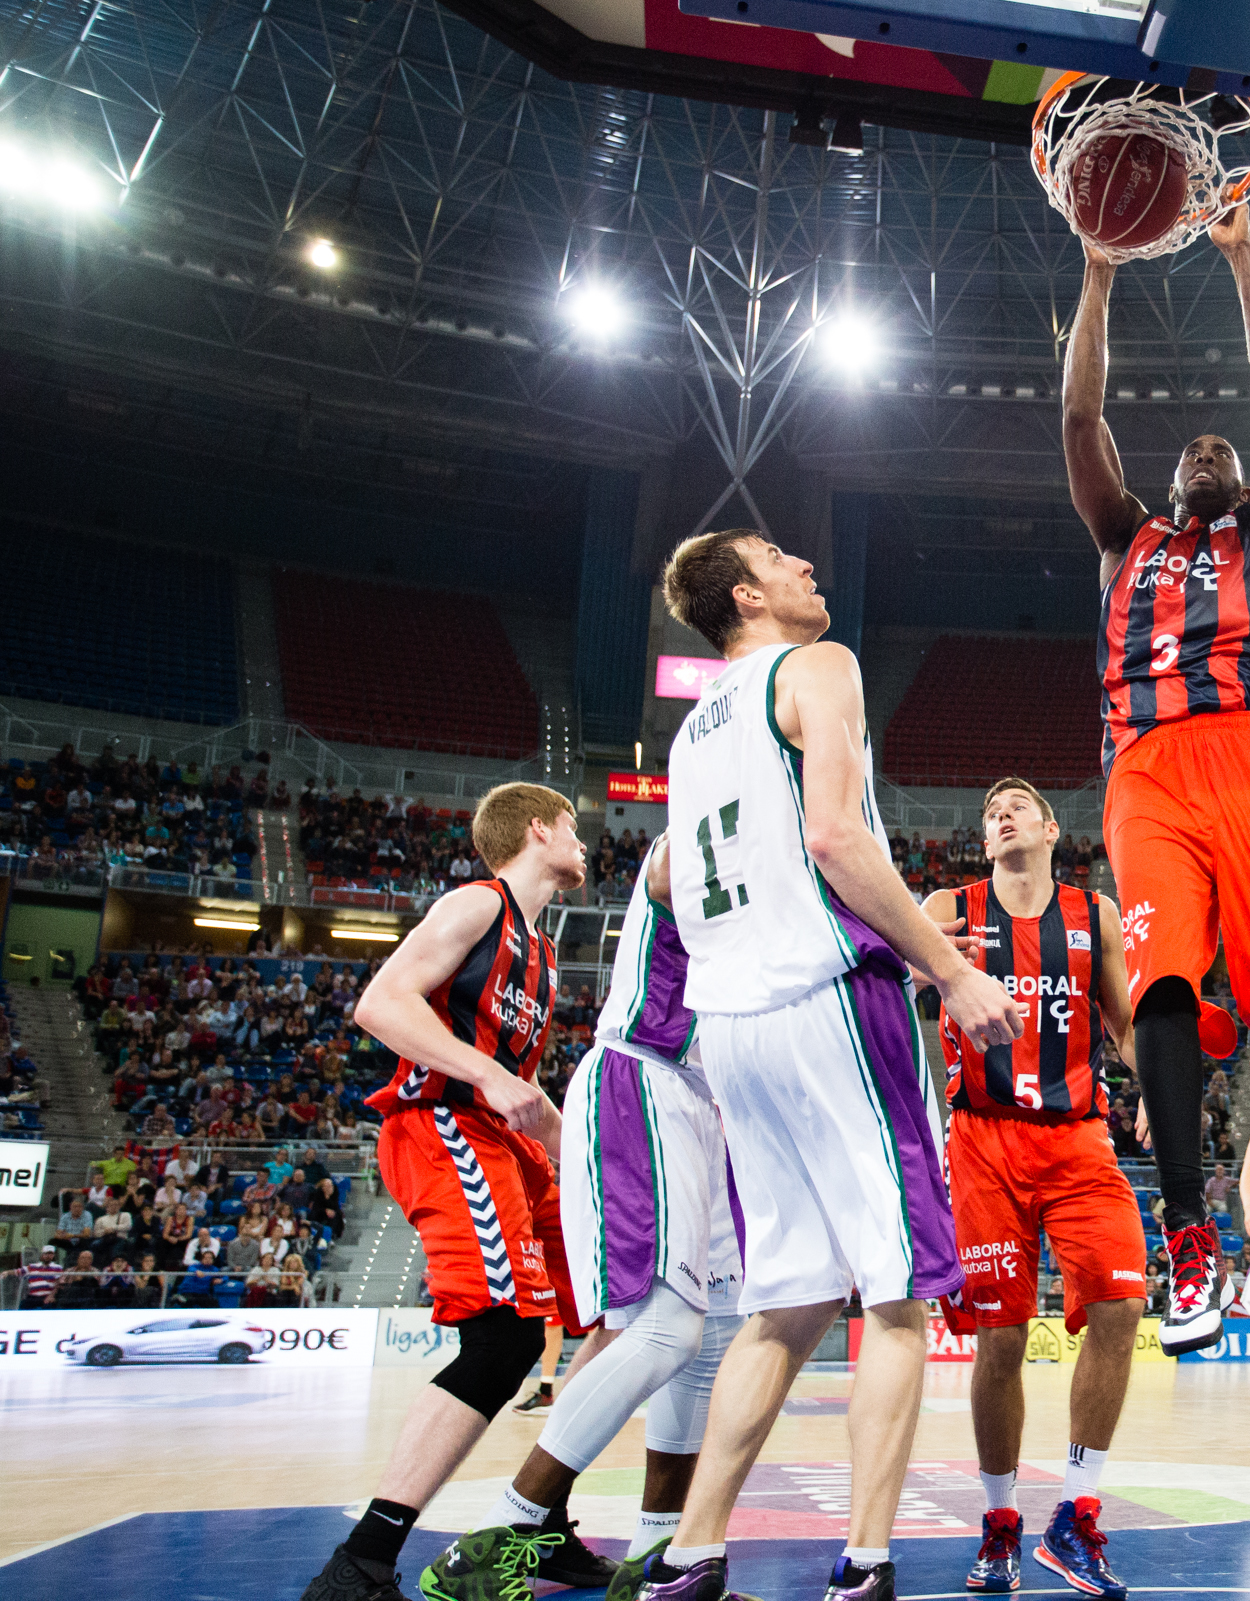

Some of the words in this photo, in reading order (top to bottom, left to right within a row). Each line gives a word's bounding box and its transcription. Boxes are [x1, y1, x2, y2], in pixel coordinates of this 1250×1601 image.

[1151, 634, 1179, 671] 3
[991, 975, 1083, 996] BORAL
[1015, 1073, 1043, 1111] 5
[960, 1240, 1020, 1260] LABORAL
[962, 1260, 992, 1275] kutxa
